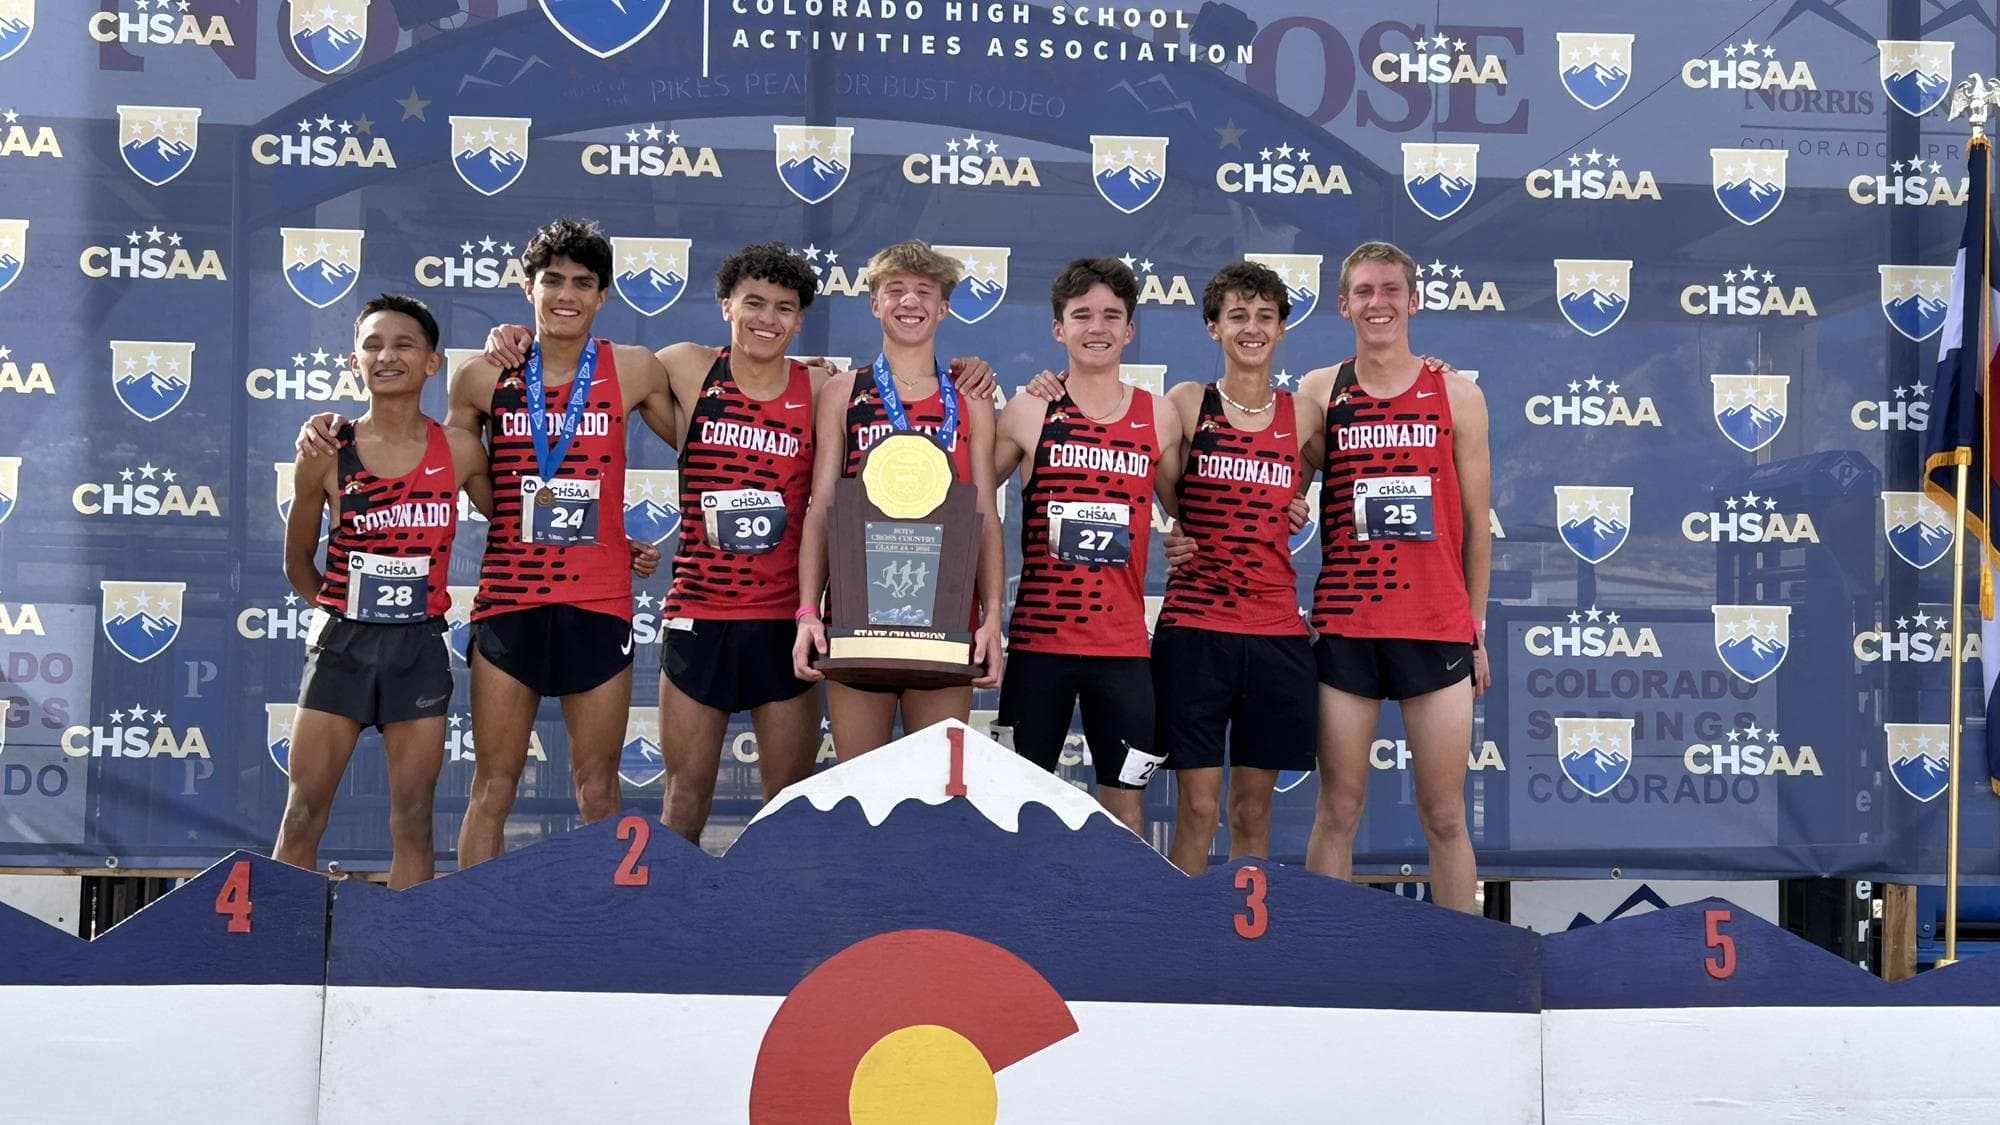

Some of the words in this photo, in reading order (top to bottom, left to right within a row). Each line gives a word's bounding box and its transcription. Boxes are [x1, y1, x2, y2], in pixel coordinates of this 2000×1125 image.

[88, 11, 235, 47] CHSAA
[732, 0, 923, 20] COLORADO
[946, 2, 1030, 24] HIGH
[1052, 5, 1190, 29] SCHOOL
[732, 29, 962, 55] ACTIVITIES
[986, 37, 1254, 64] ASSOCIATION
[744, 72, 808, 96] PEA
[1371, 51, 1508, 85] CHSAA
[1681, 58, 1818, 91] CHSAA
[251, 133, 397, 169] CHSAA
[581, 144, 723, 178] CHSAA
[902, 154, 1041, 187] CHSAA
[1216, 162, 1353, 195] CHSAA
[1525, 168, 1662, 201] CHSAA
[79, 246, 228, 281] CHSAA
[414, 255, 527, 289] CHSA
[1416, 280, 1506, 312] SAA
[1680, 284, 1818, 317] CHSAA
[1524, 395, 1663, 427] CHSAA
[1850, 400, 1930, 431] CHS
[701, 420, 799, 458] CORONADO
[1338, 423, 1438, 451] CORONADO
[1049, 443, 1150, 478] CORONADO
[1197, 454, 1292, 489] CORONADO
[71, 483, 221, 517] CHSAA
[731, 496, 771, 508] CHSAA
[1379, 485, 1417, 495] CHSAA
[352, 502, 451, 535] CORONADO
[550, 506, 585, 529] 24
[735, 516, 772, 538] 30
[1077, 509, 1117, 522] CHSAA
[1383, 504, 1418, 525] 25
[1681, 511, 1820, 544] CHSAA
[1078, 529, 1114, 551] 27
[376, 564, 417, 576] CHSAA
[376, 585, 413, 607] 28
[1524, 625, 1663, 658] CHSAA
[60, 725, 211, 759] CHSAA
[945, 727, 967, 796] 1
[1683, 744, 1824, 777] CHSAA
[614, 816, 650, 886] 2
[215, 861, 252, 932] 4
[1233, 866, 1269, 940] 3
[1704, 909, 1737, 980] 5
